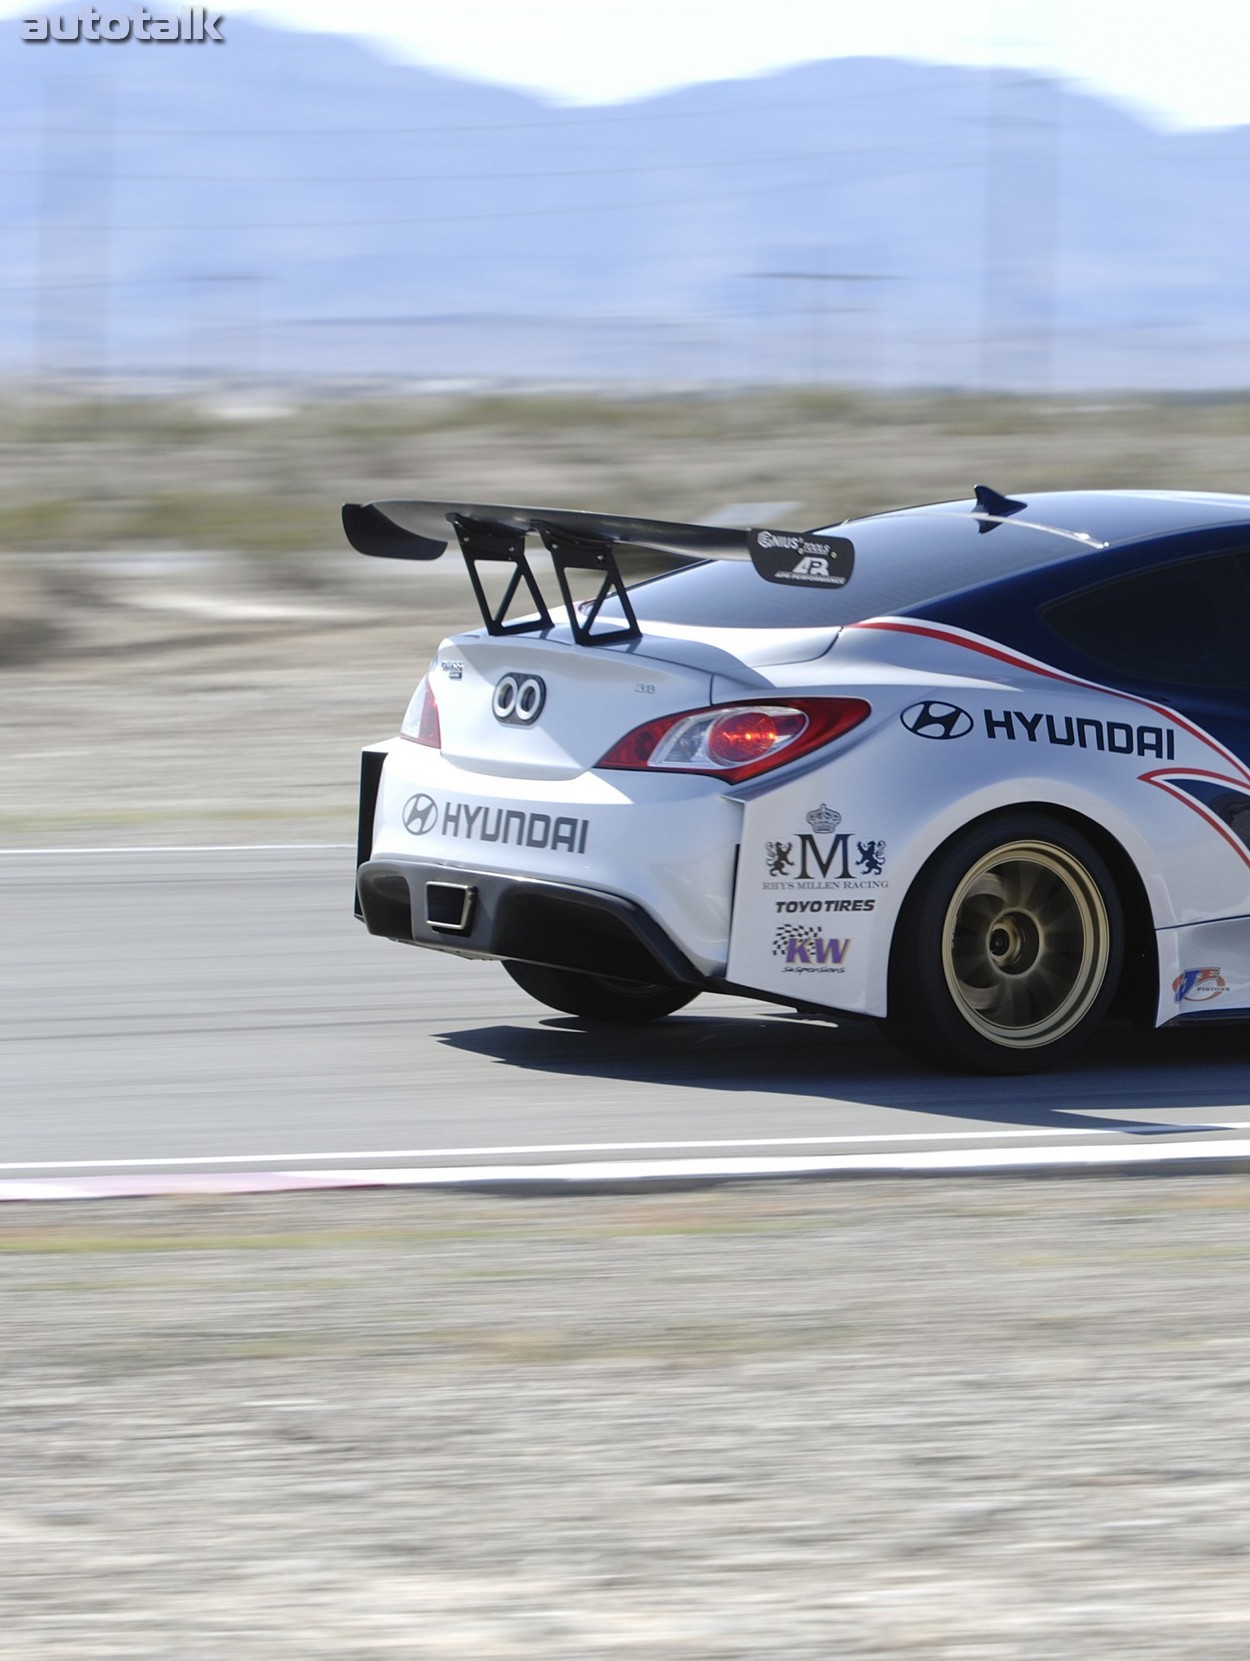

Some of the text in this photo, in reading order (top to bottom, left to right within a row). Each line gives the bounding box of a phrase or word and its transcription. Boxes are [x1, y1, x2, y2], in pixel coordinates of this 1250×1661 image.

[983, 708, 1175, 760] HYUNDAI
[442, 802, 589, 854] HYUNDAI
[794, 834, 857, 879] M
[762, 880, 889, 890] RHYS MILLEN RACING
[776, 899, 876, 913] TOYO TIRES
[785, 938, 850, 964] KW
